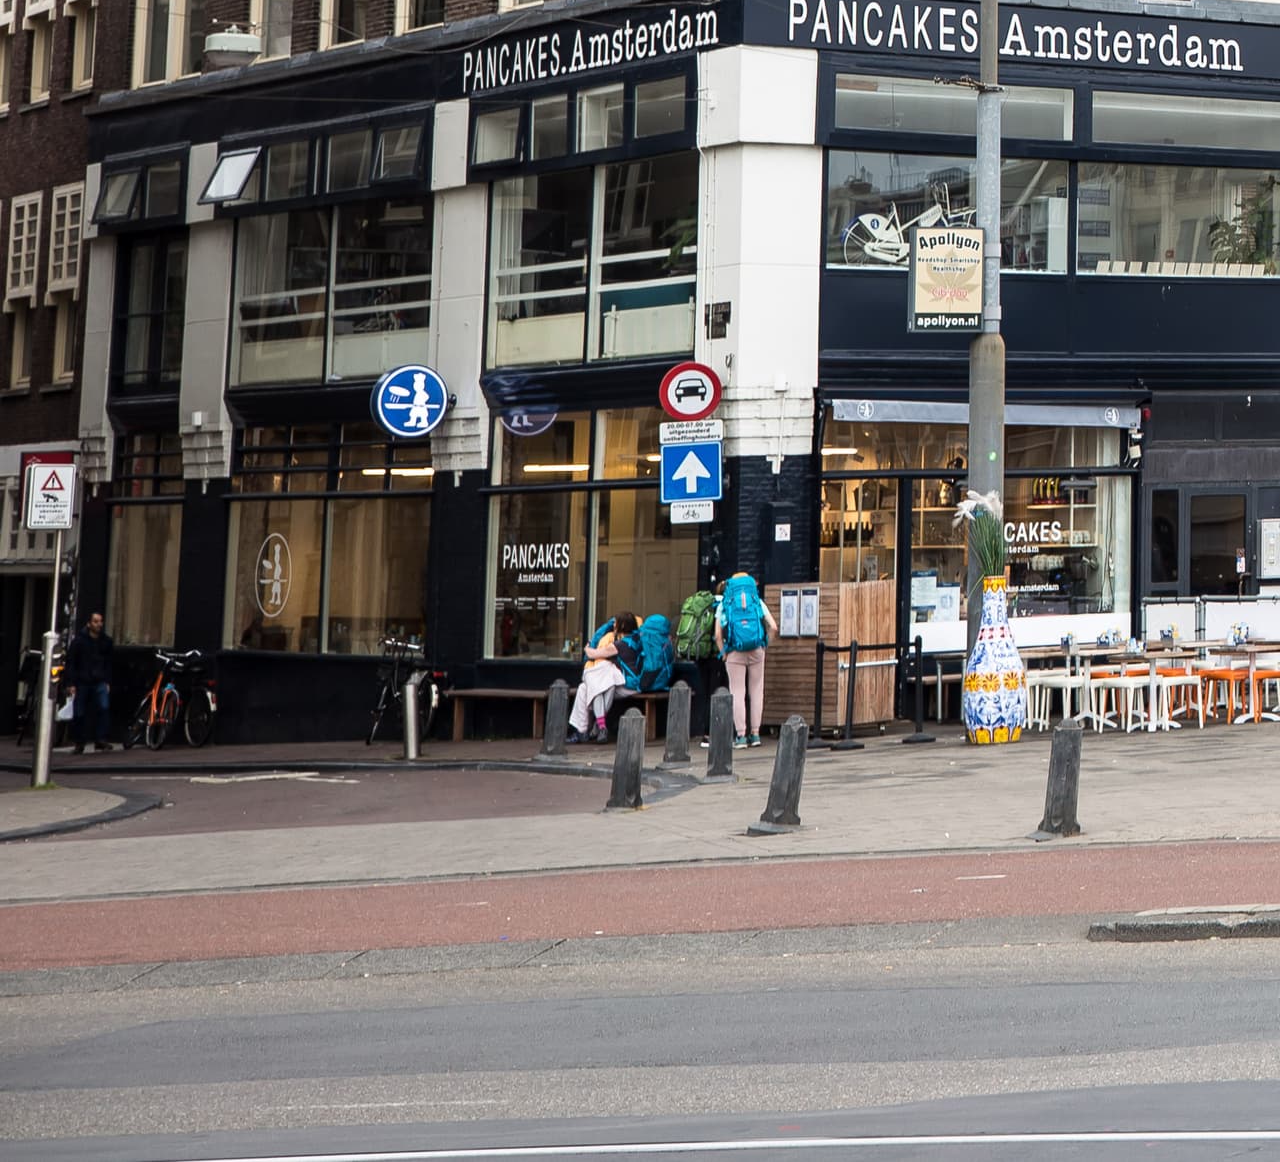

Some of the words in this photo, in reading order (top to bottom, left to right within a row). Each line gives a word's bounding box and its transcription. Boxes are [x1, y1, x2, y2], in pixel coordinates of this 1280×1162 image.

[999, 13, 1244, 72] Amsterdam
[919, 232, 980, 251] Apollyon
[917, 316, 979, 328] apollyon.nl
[1003, 521, 1063, 543] CAKES
[503, 542, 570, 570] PANCAKES
[517, 572, 555, 583] Amsterdam
